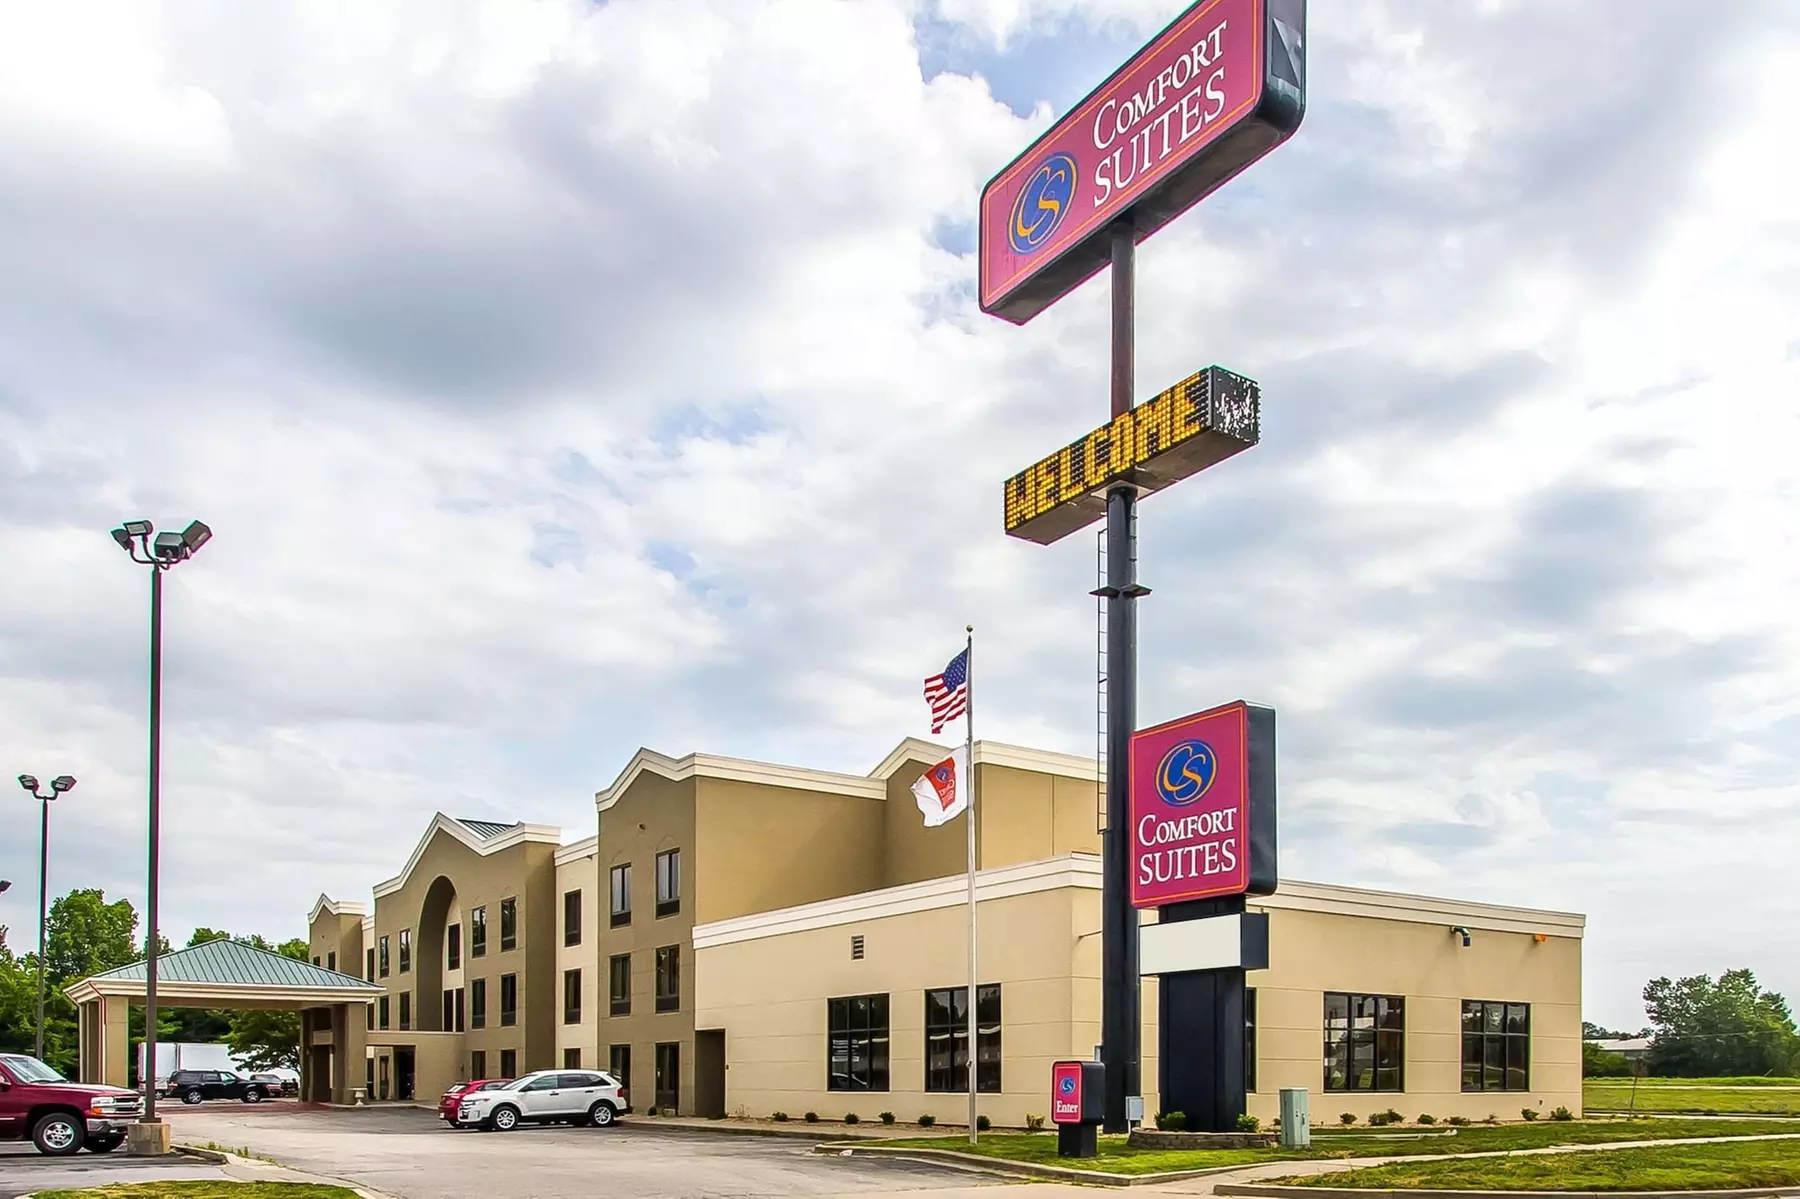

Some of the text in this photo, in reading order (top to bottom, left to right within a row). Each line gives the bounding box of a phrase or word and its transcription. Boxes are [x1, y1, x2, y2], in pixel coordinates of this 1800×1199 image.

[1093, 20, 1227, 150] COMFORT
[1093, 67, 1225, 207] SUITES
[1006, 371, 1201, 530] WELCOME
[1138, 807, 1237, 847] COMFORT
[1138, 838, 1236, 885] SUITES
[1056, 1100, 1078, 1113] Enter
